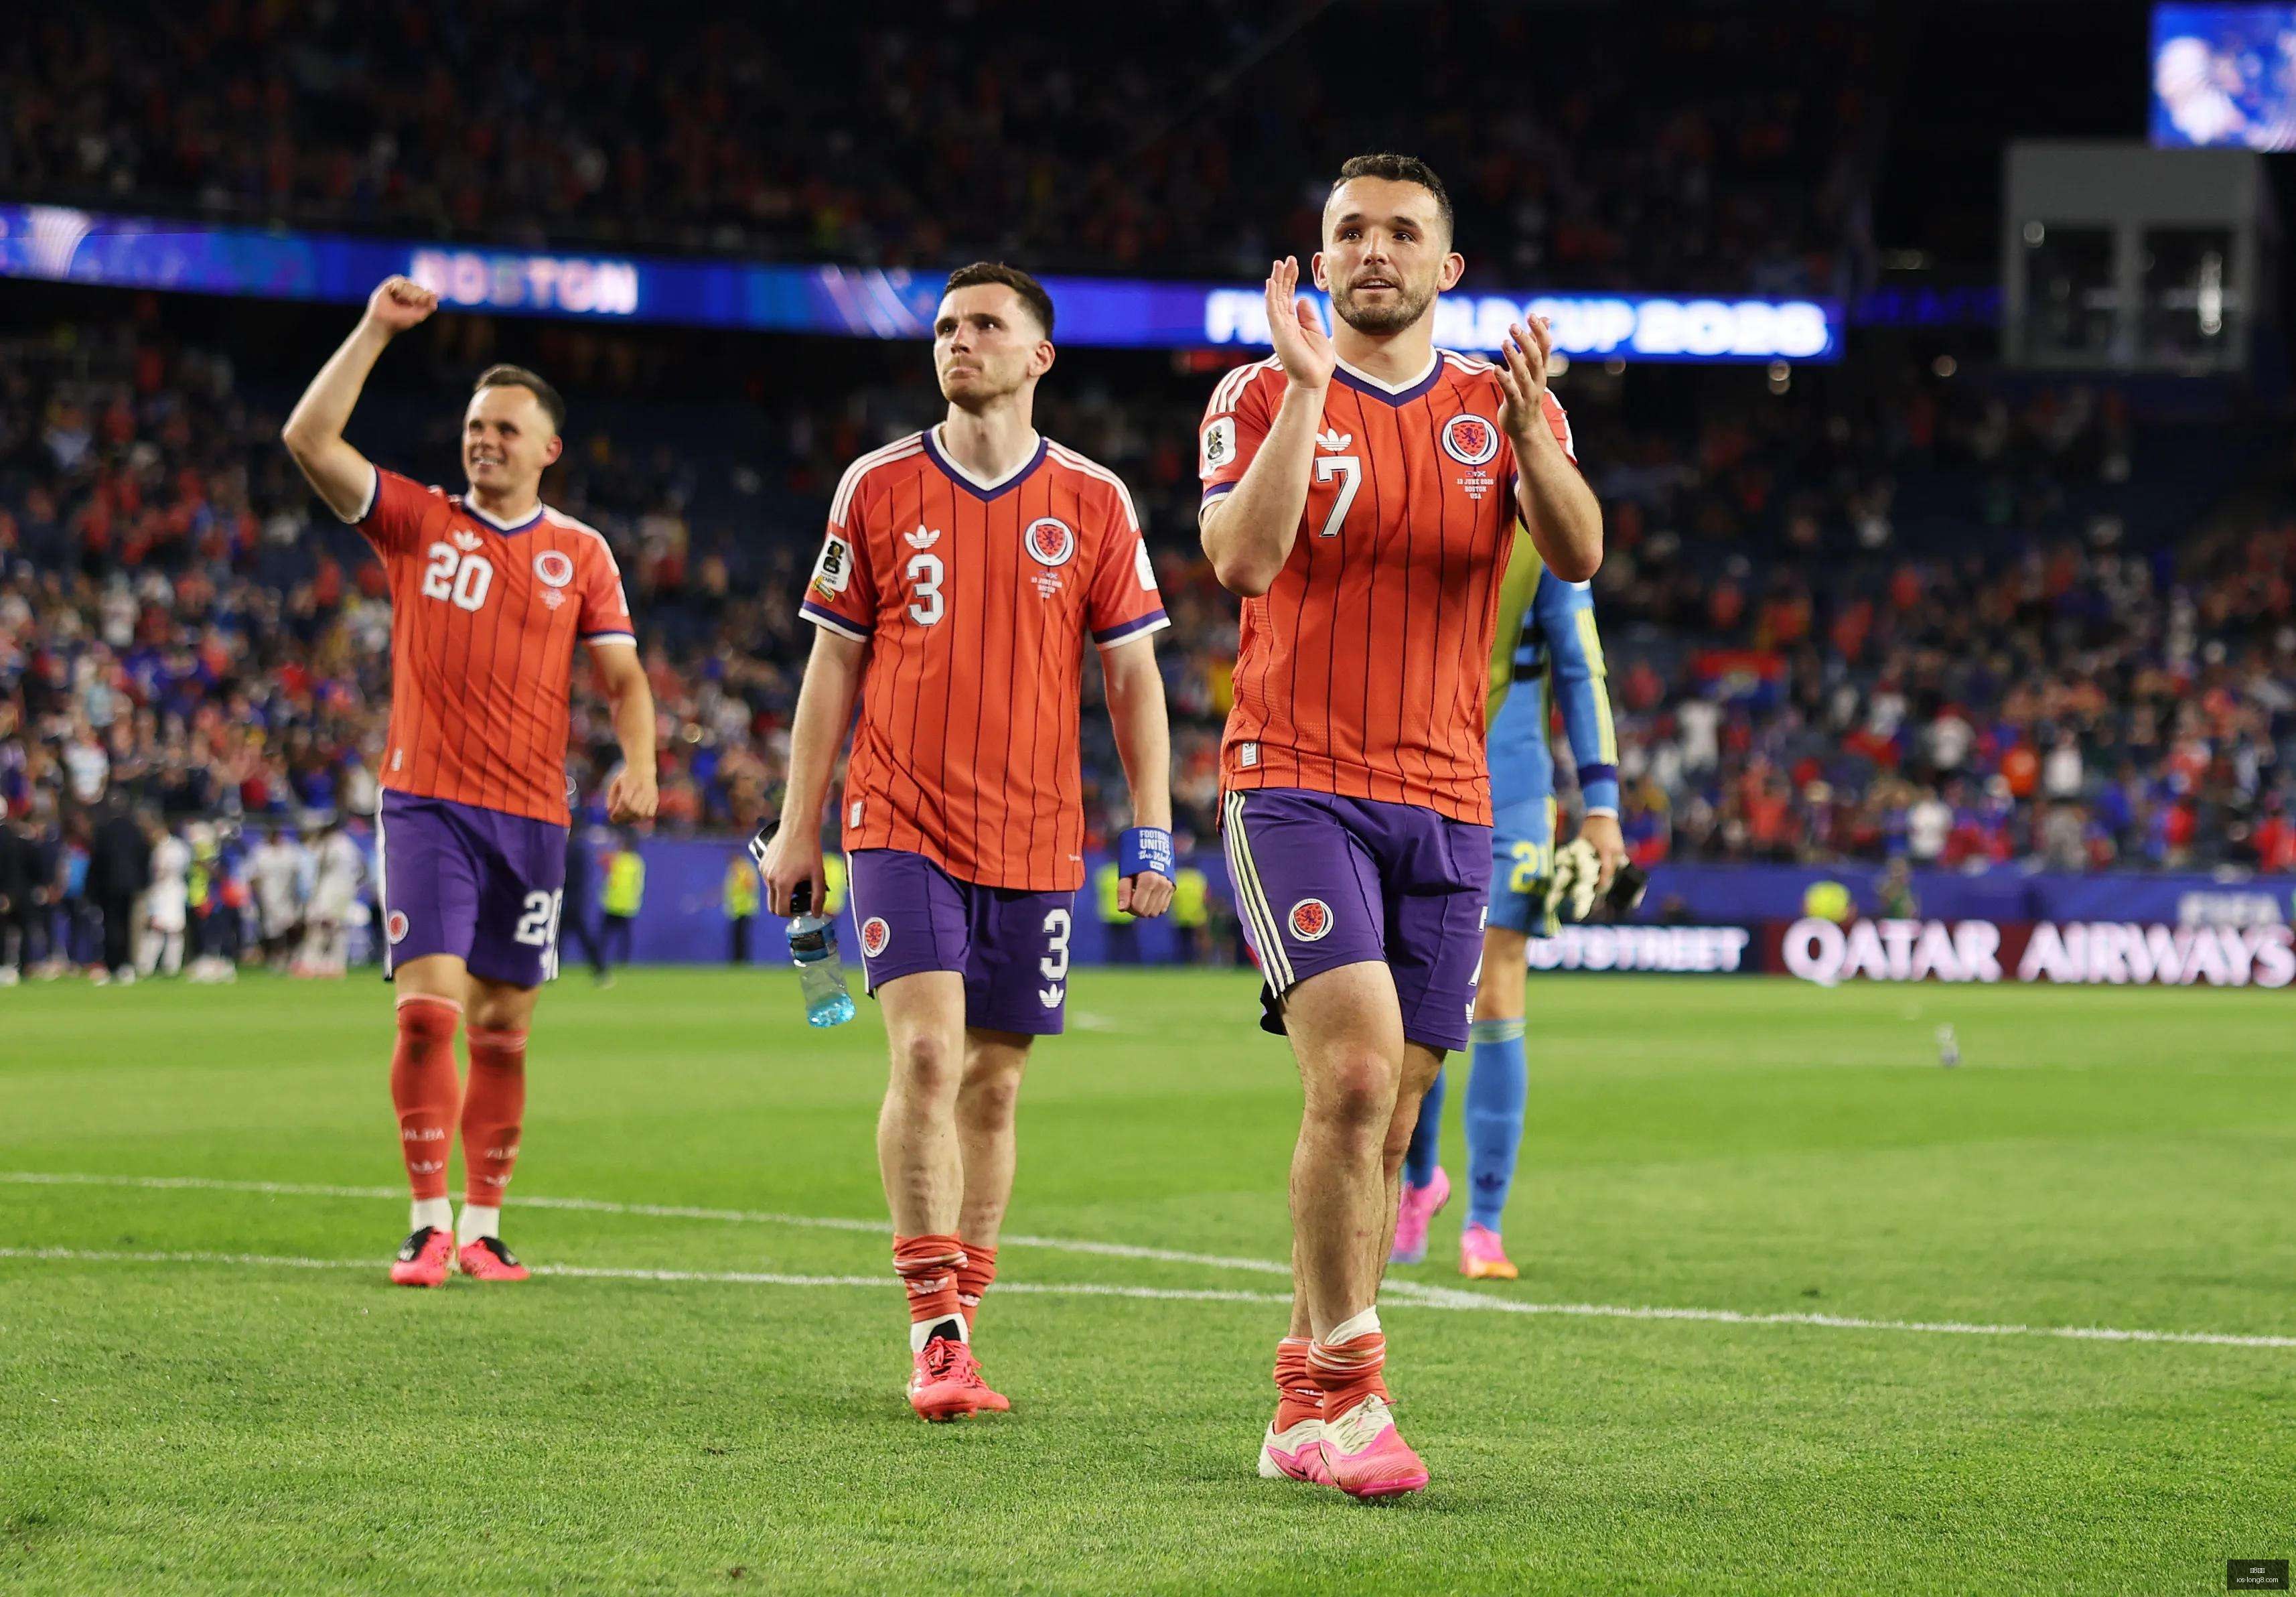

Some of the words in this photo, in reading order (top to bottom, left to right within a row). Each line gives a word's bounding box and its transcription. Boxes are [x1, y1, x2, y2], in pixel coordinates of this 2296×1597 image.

[411, 249, 638, 314] BOSTON
[1315, 456, 1362, 537] 7
[423, 541, 493, 612] 20
[906, 554, 945, 626] 3
[1039, 908, 1072, 981] 3
[1783, 918, 2003, 987] QATAR
[2017, 921, 2296, 988] AIRWAYS
